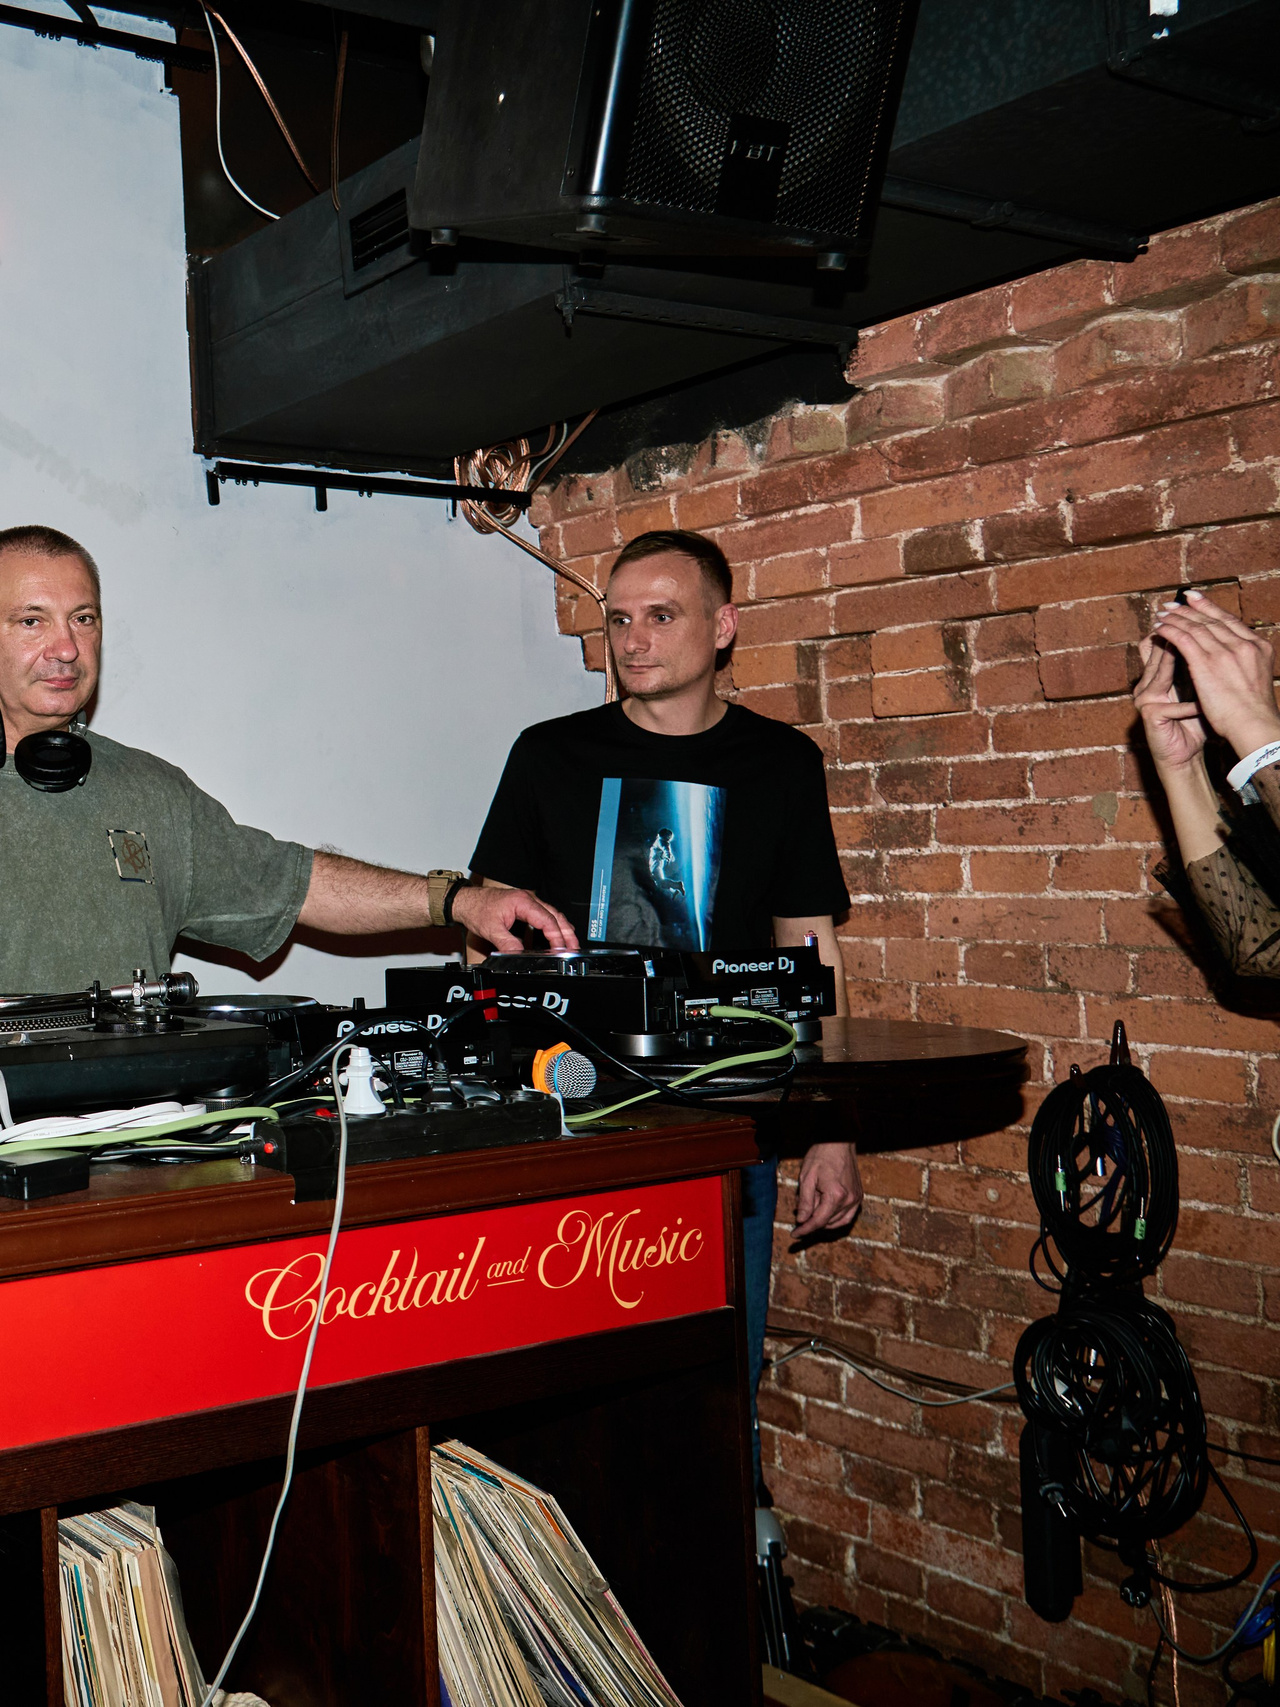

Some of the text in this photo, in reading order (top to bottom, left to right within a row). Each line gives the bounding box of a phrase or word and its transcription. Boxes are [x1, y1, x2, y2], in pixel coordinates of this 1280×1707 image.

[590, 919, 598, 938] BOSS
[712, 959, 774, 974] Pioneer
[245, 1208, 704, 1340] Cocktail and Music
